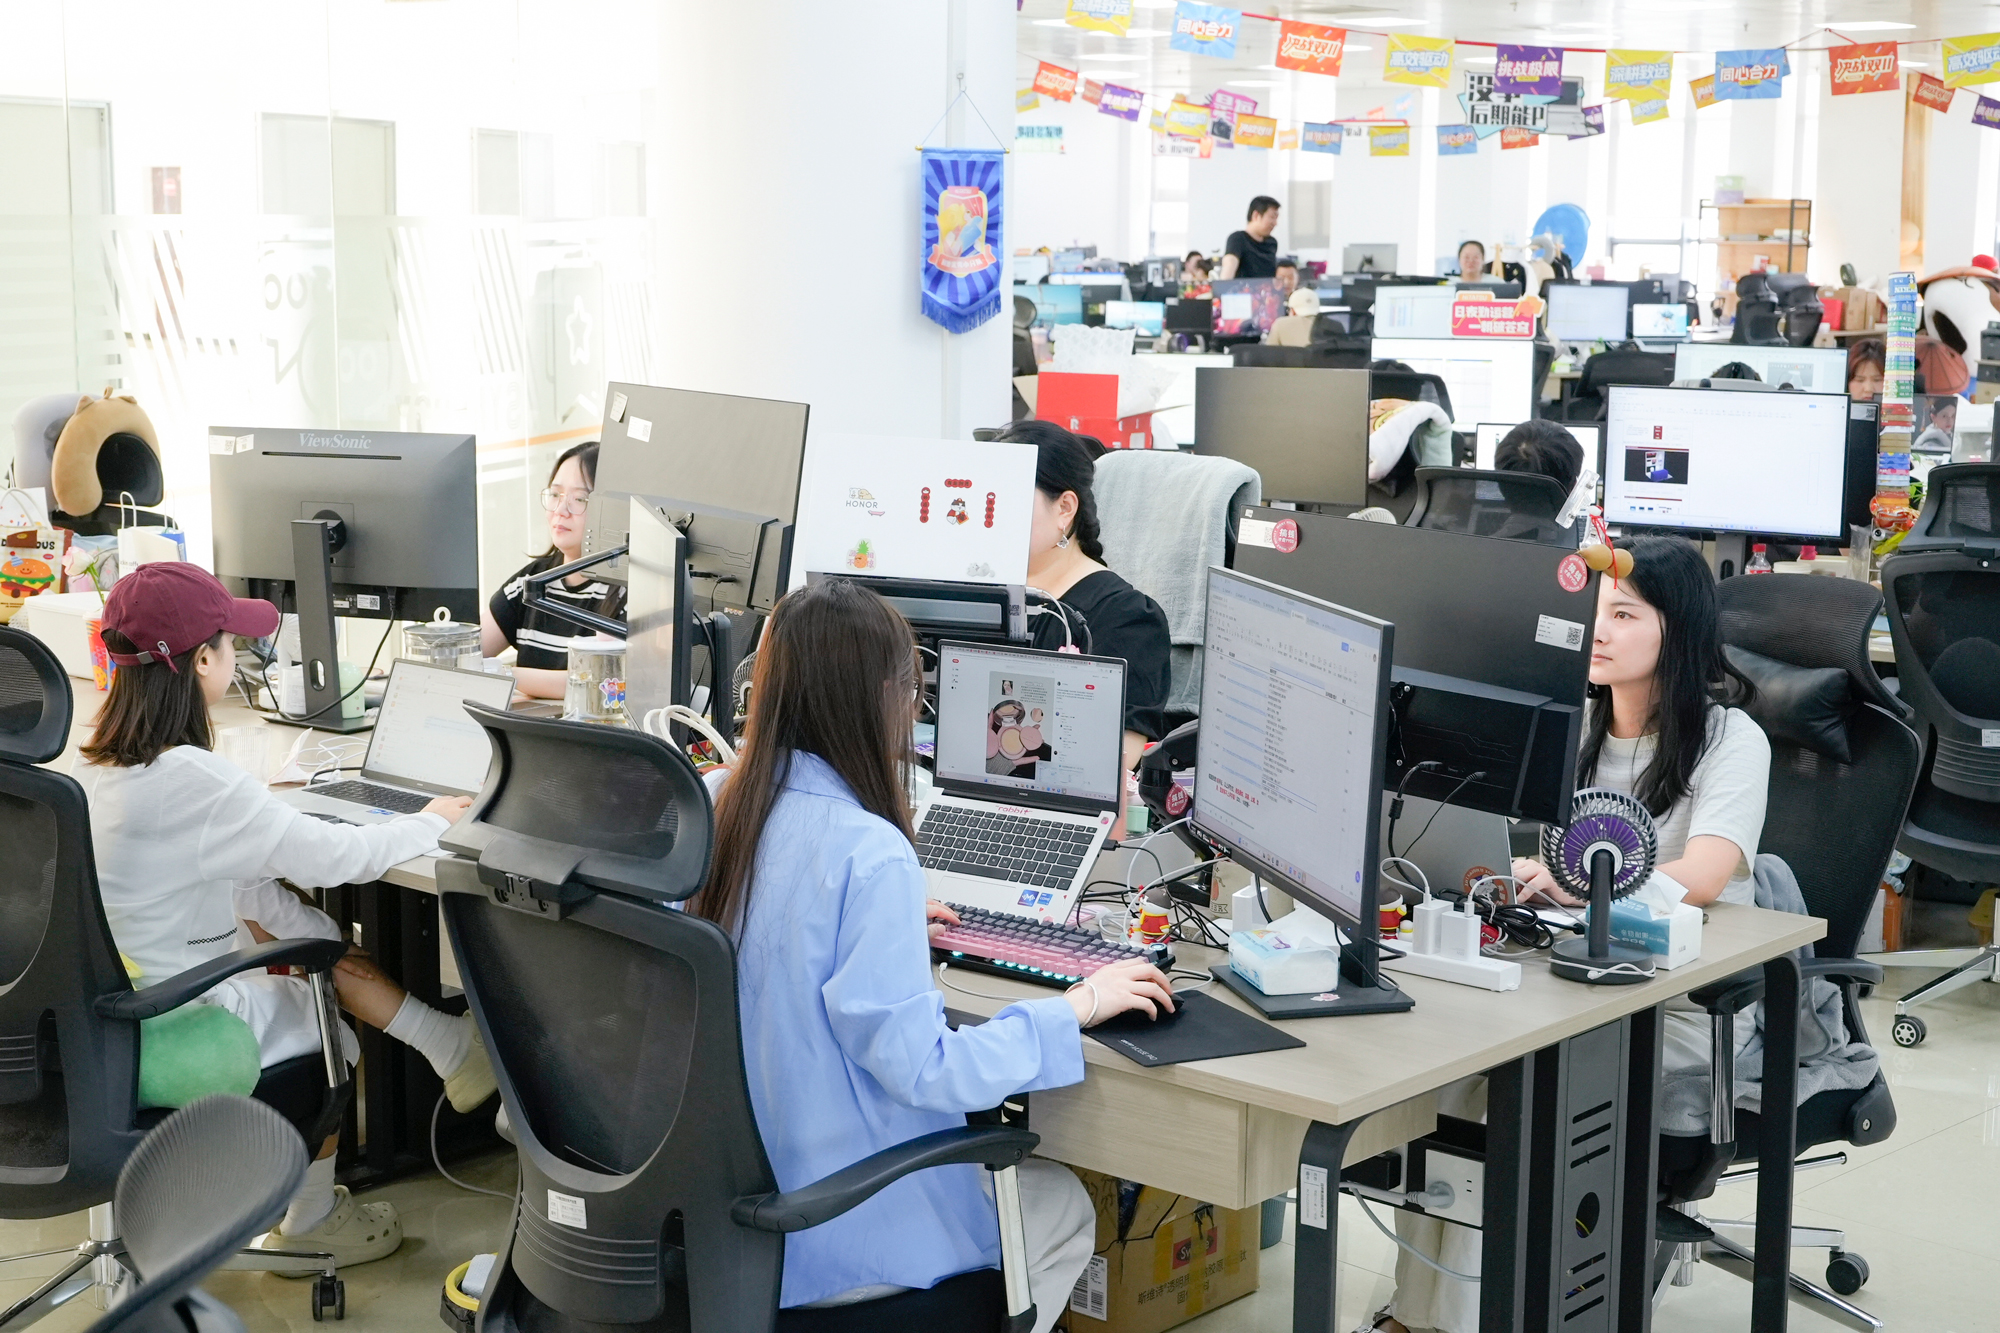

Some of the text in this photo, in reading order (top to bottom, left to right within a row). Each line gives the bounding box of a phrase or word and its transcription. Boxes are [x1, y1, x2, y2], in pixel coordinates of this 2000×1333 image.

[1176, 19, 1234, 38] 同心合力
[1389, 50, 1450, 68] 高效驱动
[1497, 60, 1560, 77] 挑战极限
[1609, 63, 1670, 83] 深耕致远
[1719, 63, 1779, 83] 同心合力
[299, 433, 371, 449] ViewSonic
[845, 500, 878, 508] HONOR
[998, 806, 1030, 815] rabbit
